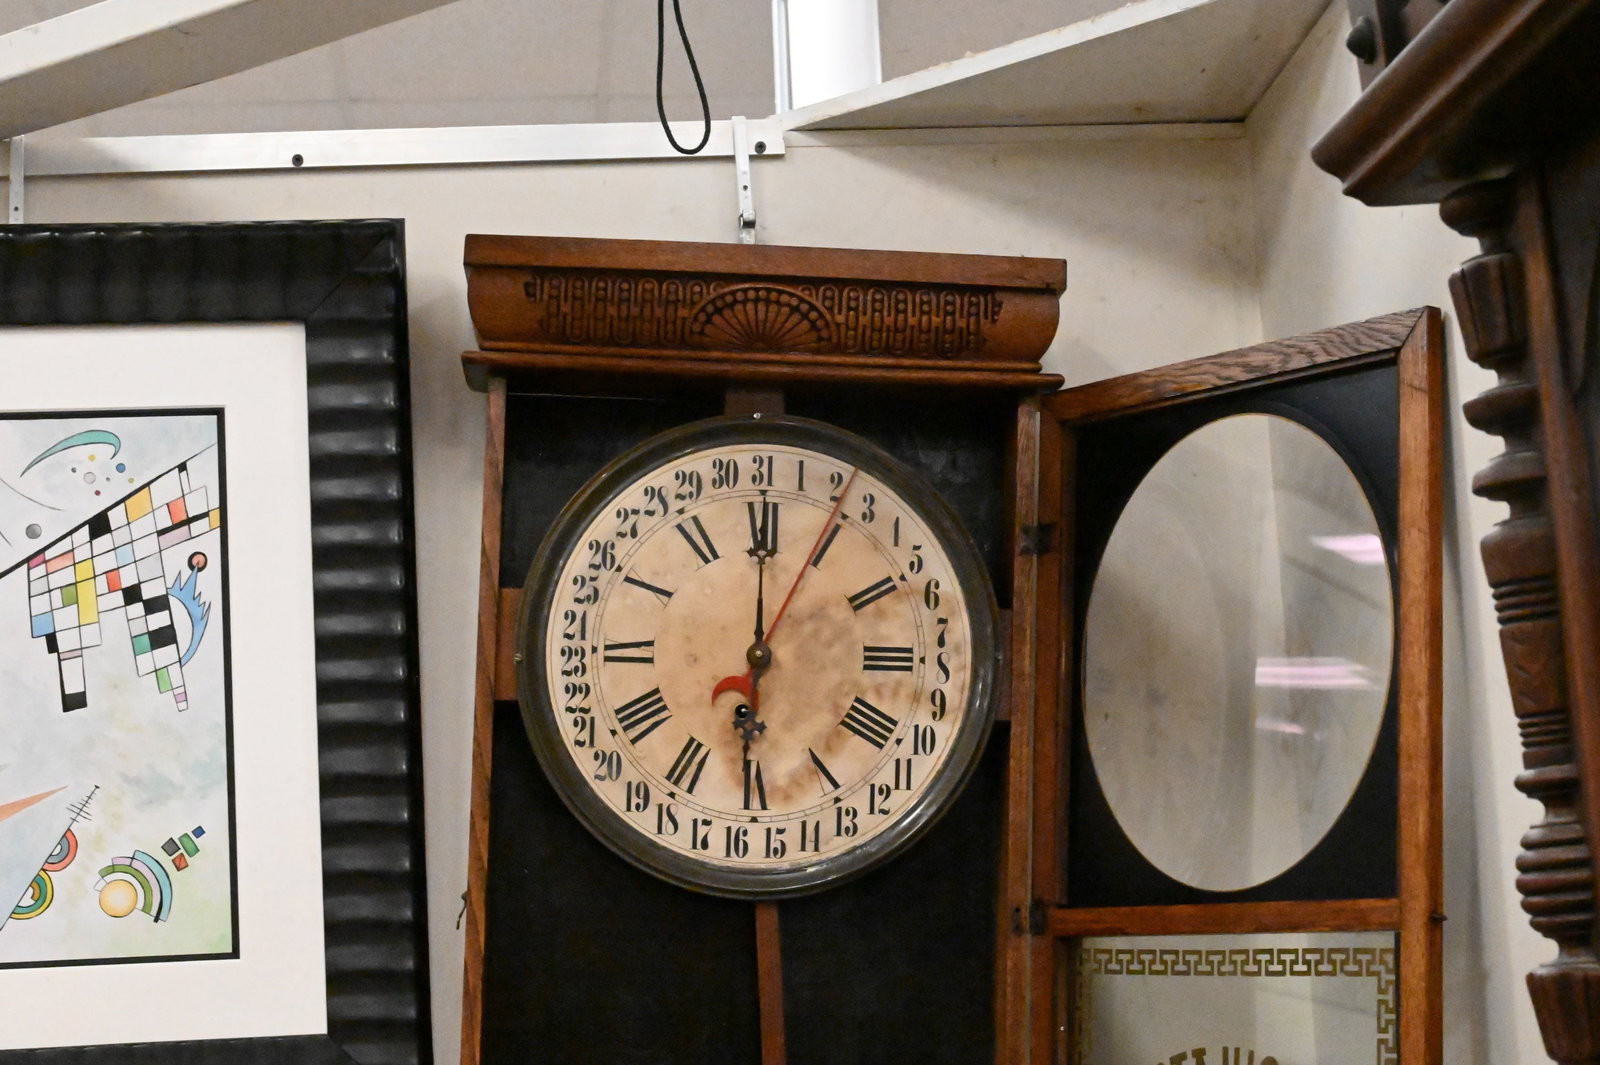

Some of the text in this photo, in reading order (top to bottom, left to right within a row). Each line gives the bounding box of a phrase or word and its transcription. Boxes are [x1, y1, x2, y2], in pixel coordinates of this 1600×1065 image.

[674, 470, 703, 501] 29
[711, 458, 739, 489] 30
[752, 455, 775, 487] 31
[797, 459, 806, 491] 1
[829, 471, 844, 503] 2
[644, 485, 670, 517] 28
[861, 492, 875, 524] 3
[616, 507, 641, 539] 27
[588, 539, 616, 572] 26
[909, 544, 923, 574] 5
[572, 574, 600, 605] 25
[844, 575, 899, 616] II
[924, 578, 940, 611] 6
[936, 617, 949, 649] 7
[560, 645, 587, 677] 23
[863, 643, 914, 673] III
[936, 651, 950, 685] 8
[564, 682, 591, 714] 22
[930, 688, 947, 722] 9
[572, 716, 596, 748] 21
[910, 724, 936, 756] 10
[593, 749, 623, 782] 20
[891, 758, 912, 791] 11
[624, 780, 650, 813] 19
[867, 783, 892, 816] 12
[655, 802, 679, 836] 18
[690, 818, 713, 850] 17
[833, 806, 858, 837] 13
[723, 825, 749, 858] 16
[762, 826, 787, 859] 15
[797, 820, 821, 852] 14
